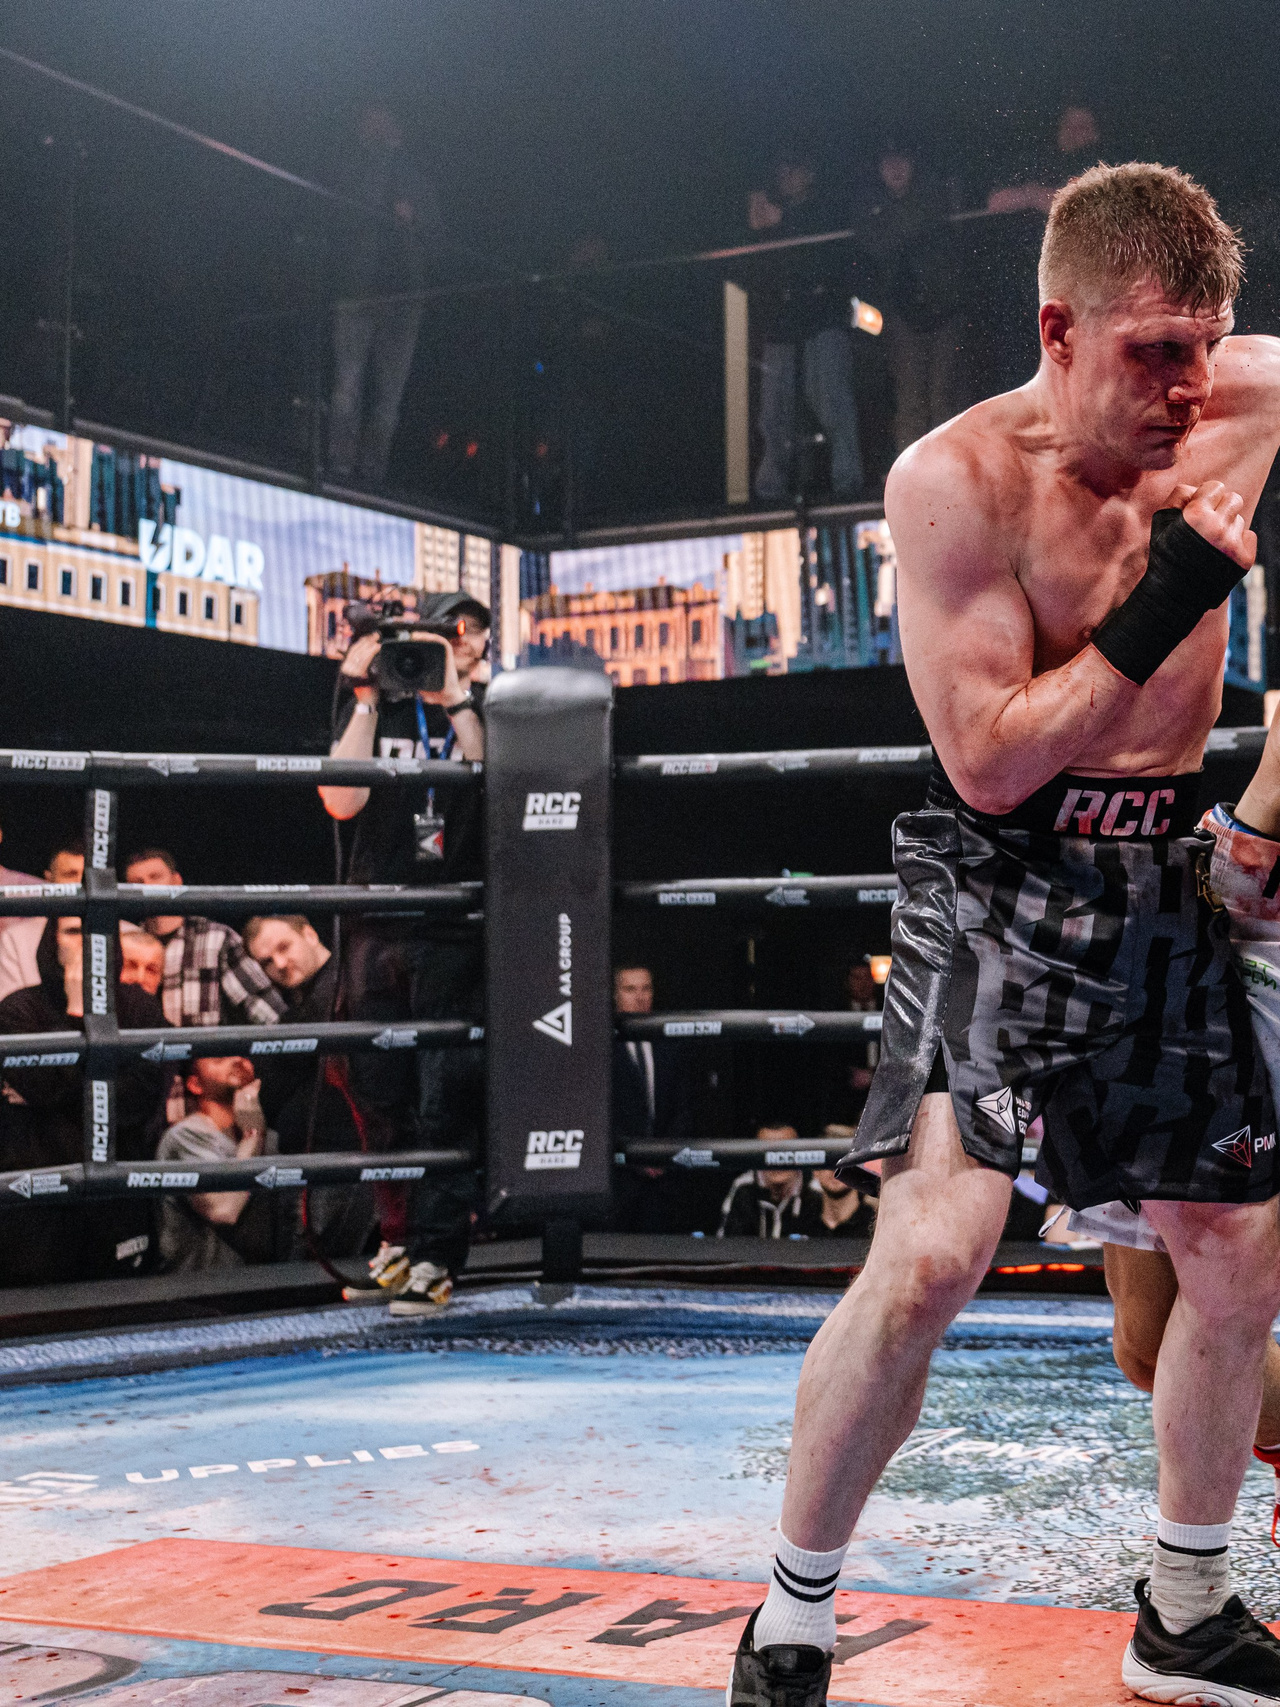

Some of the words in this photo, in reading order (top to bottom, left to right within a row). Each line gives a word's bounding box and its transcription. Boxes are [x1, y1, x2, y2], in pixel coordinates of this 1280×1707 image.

[138, 518, 264, 590] UDAR
[525, 792, 582, 815] RCC
[1053, 788, 1175, 836] RCC
[92, 831, 109, 869] RCC
[558, 913, 572, 971] GROUP
[92, 976, 107, 1015] RCC
[558, 971, 572, 996] AA
[92, 1123, 108, 1162] RCC
[527, 1130, 584, 1153] RCC
[127, 1173, 162, 1187] RCC
[125, 1440, 480, 1484] UPPLIES
